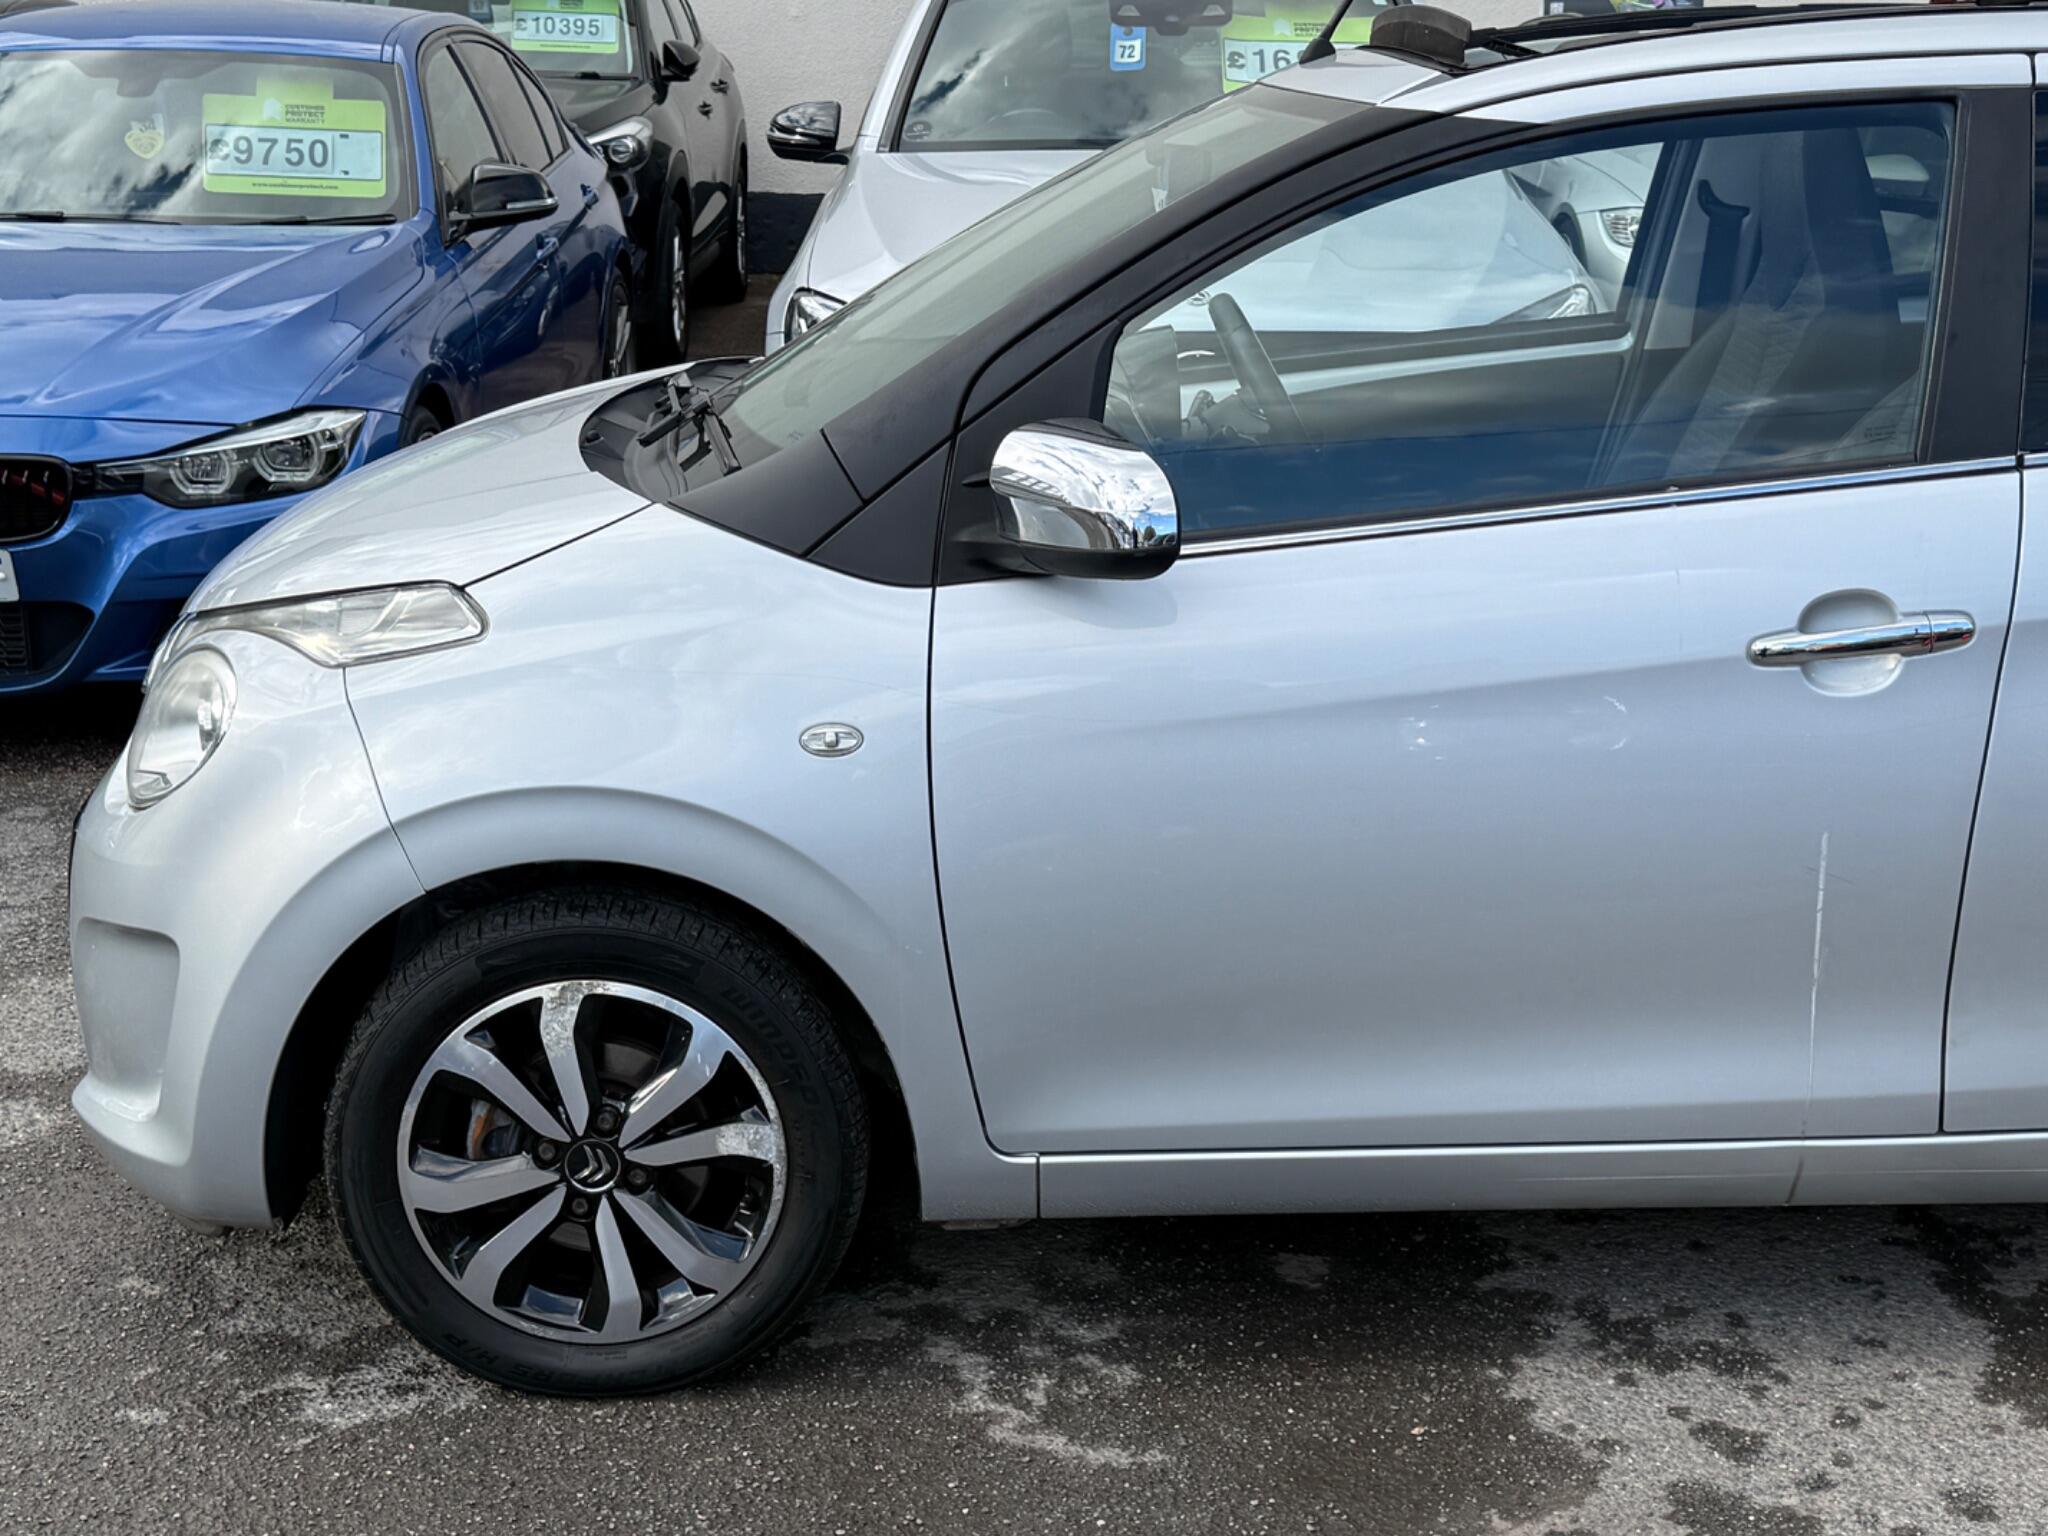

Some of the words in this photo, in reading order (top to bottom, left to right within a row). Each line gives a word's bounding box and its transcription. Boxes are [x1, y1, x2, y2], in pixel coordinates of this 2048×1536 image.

[514, 16, 600, 36] £10395
[1118, 44, 1136, 59] 72
[1227, 48, 1305, 73] £16
[285, 110, 325, 118] PROTECT
[208, 136, 329, 168] £9750
